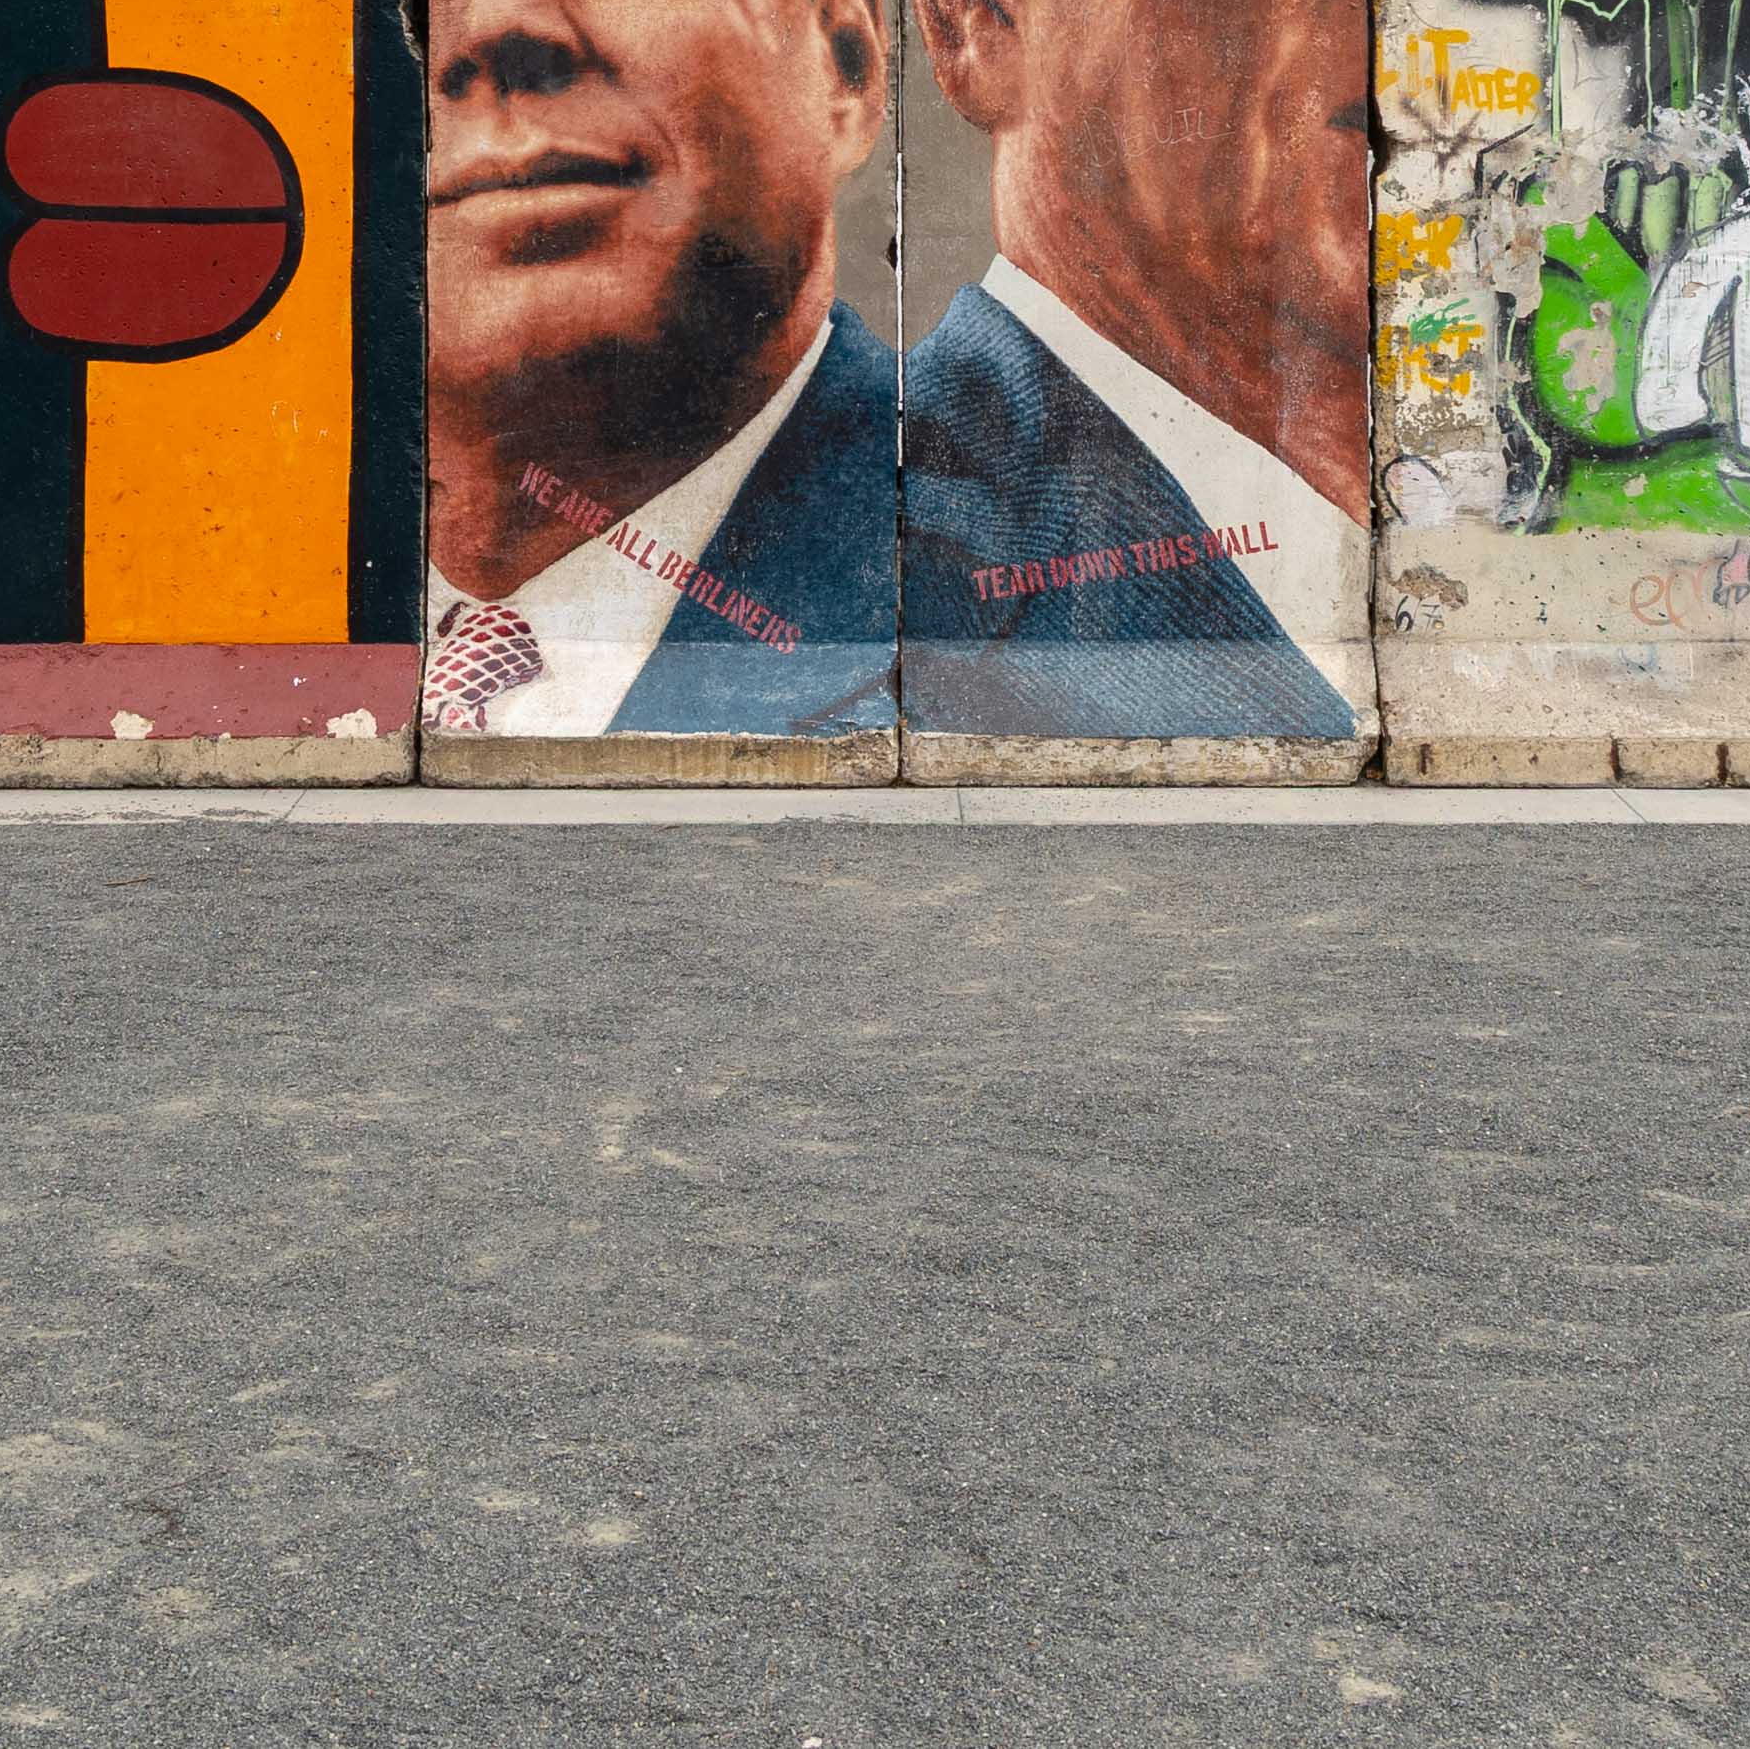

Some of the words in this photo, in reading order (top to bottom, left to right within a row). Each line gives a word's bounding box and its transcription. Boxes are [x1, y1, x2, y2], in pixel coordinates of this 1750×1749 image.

[518, 461, 564, 507] WE
[554, 489, 614, 539] ARE
[606, 522, 658, 571] ALL
[657, 550, 802, 655] BERLINERS
[971, 560, 1046, 601] TEAR
[1049, 546, 1127, 587] DOWN
[1129, 533, 1196, 574] THIS
[1201, 521, 1279, 560] WALL
